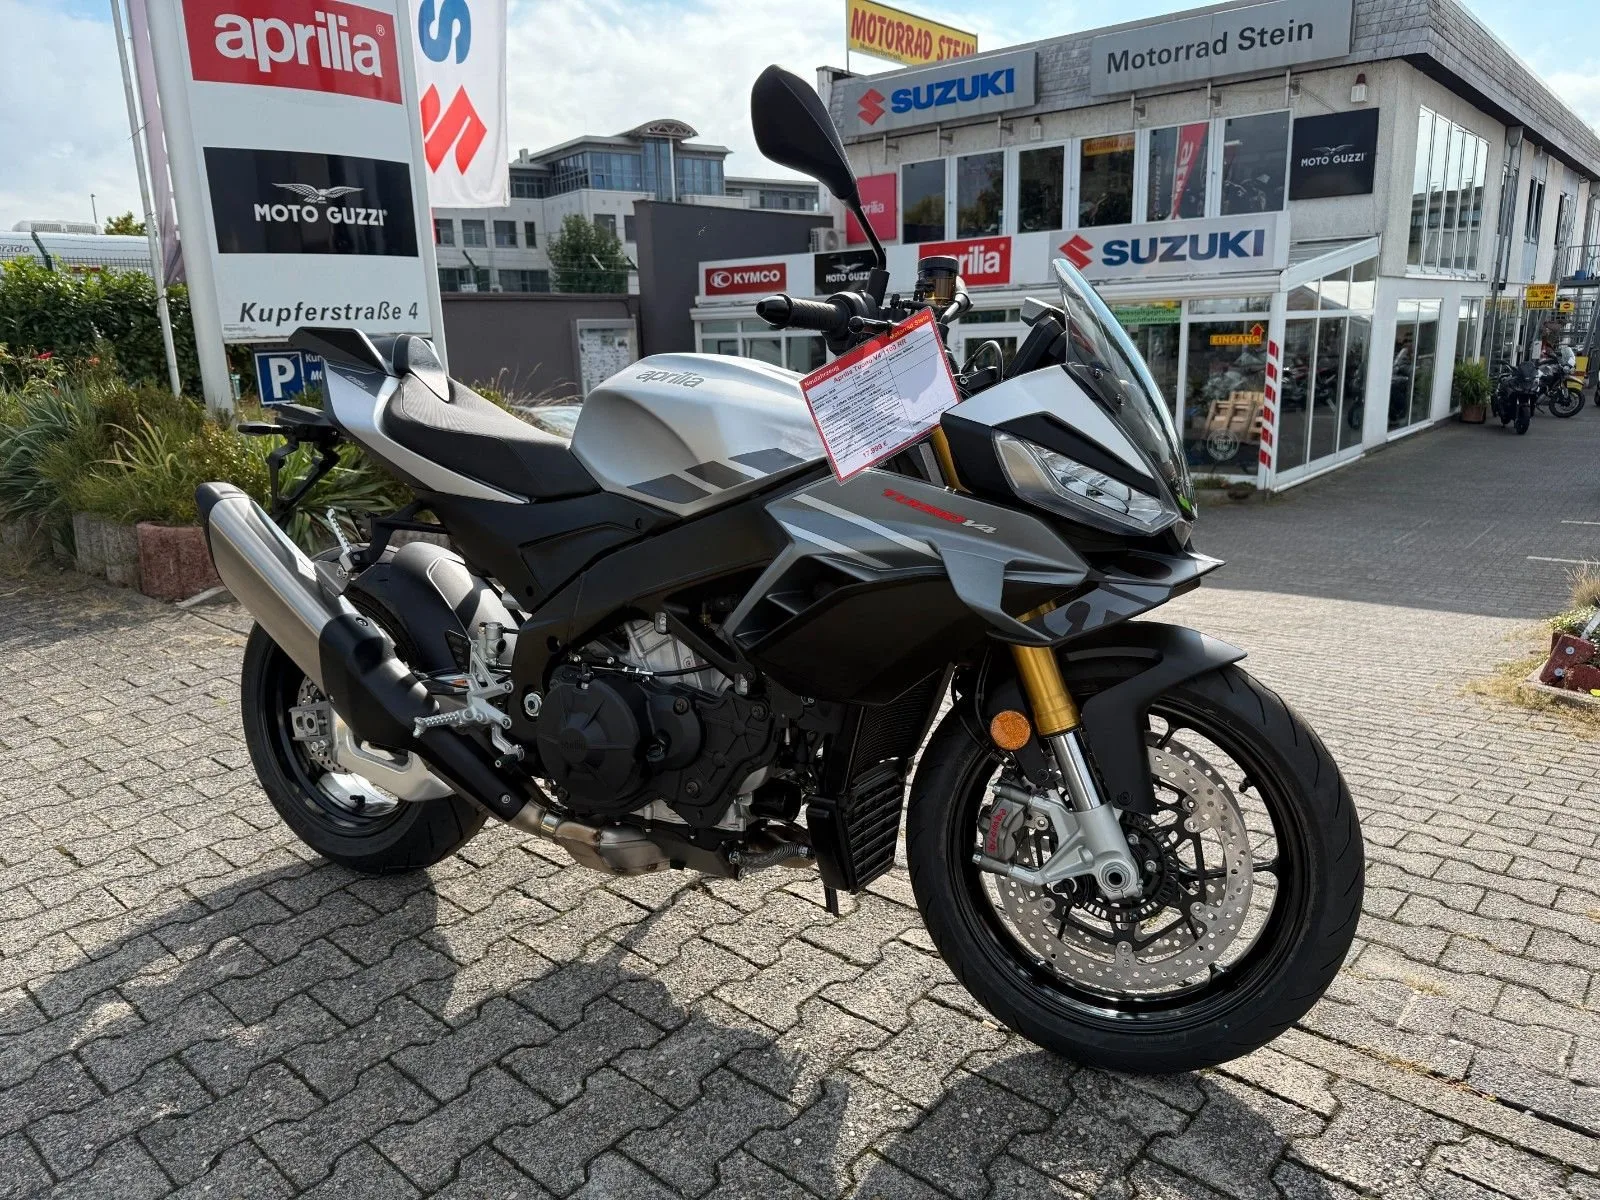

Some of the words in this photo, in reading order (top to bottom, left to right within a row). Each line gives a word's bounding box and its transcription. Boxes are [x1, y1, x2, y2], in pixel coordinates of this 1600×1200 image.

[214, 10, 383, 78] aprilia
[851, 8, 932, 60] MOTORRAD
[1107, 32, 1228, 74] Motorrad
[1238, 19, 1313, 51] Stein
[891, 68, 1014, 114] SUZUKI
[1301, 156, 1329, 167] MOTO
[1333, 152, 1365, 164] GUZZI
[254, 203, 319, 223] MOTO
[326, 206, 384, 226] GUZZI
[860, 200, 884, 215] prilia
[0, 245, 29, 253] rado
[957, 244, 1000, 275] rilia
[1102, 229, 1265, 267] SUZUKI
[734, 270, 781, 285] KYMCO
[826, 273, 846, 283] MOTO
[848, 271, 871, 281] GUZZ
[240, 301, 402, 327] Kupferstraße
[408, 302, 418, 320] 4
[914, 315, 929, 326] Stein
[1212, 335, 1261, 344] EINGANG
[833, 369, 853, 383] Aprilia
[873, 353, 882, 361] V4
[897, 338, 907, 348] RR
[268, 357, 295, 399] P
[636, 370, 704, 388] aprilia
[962, 519, 997, 534] V4
